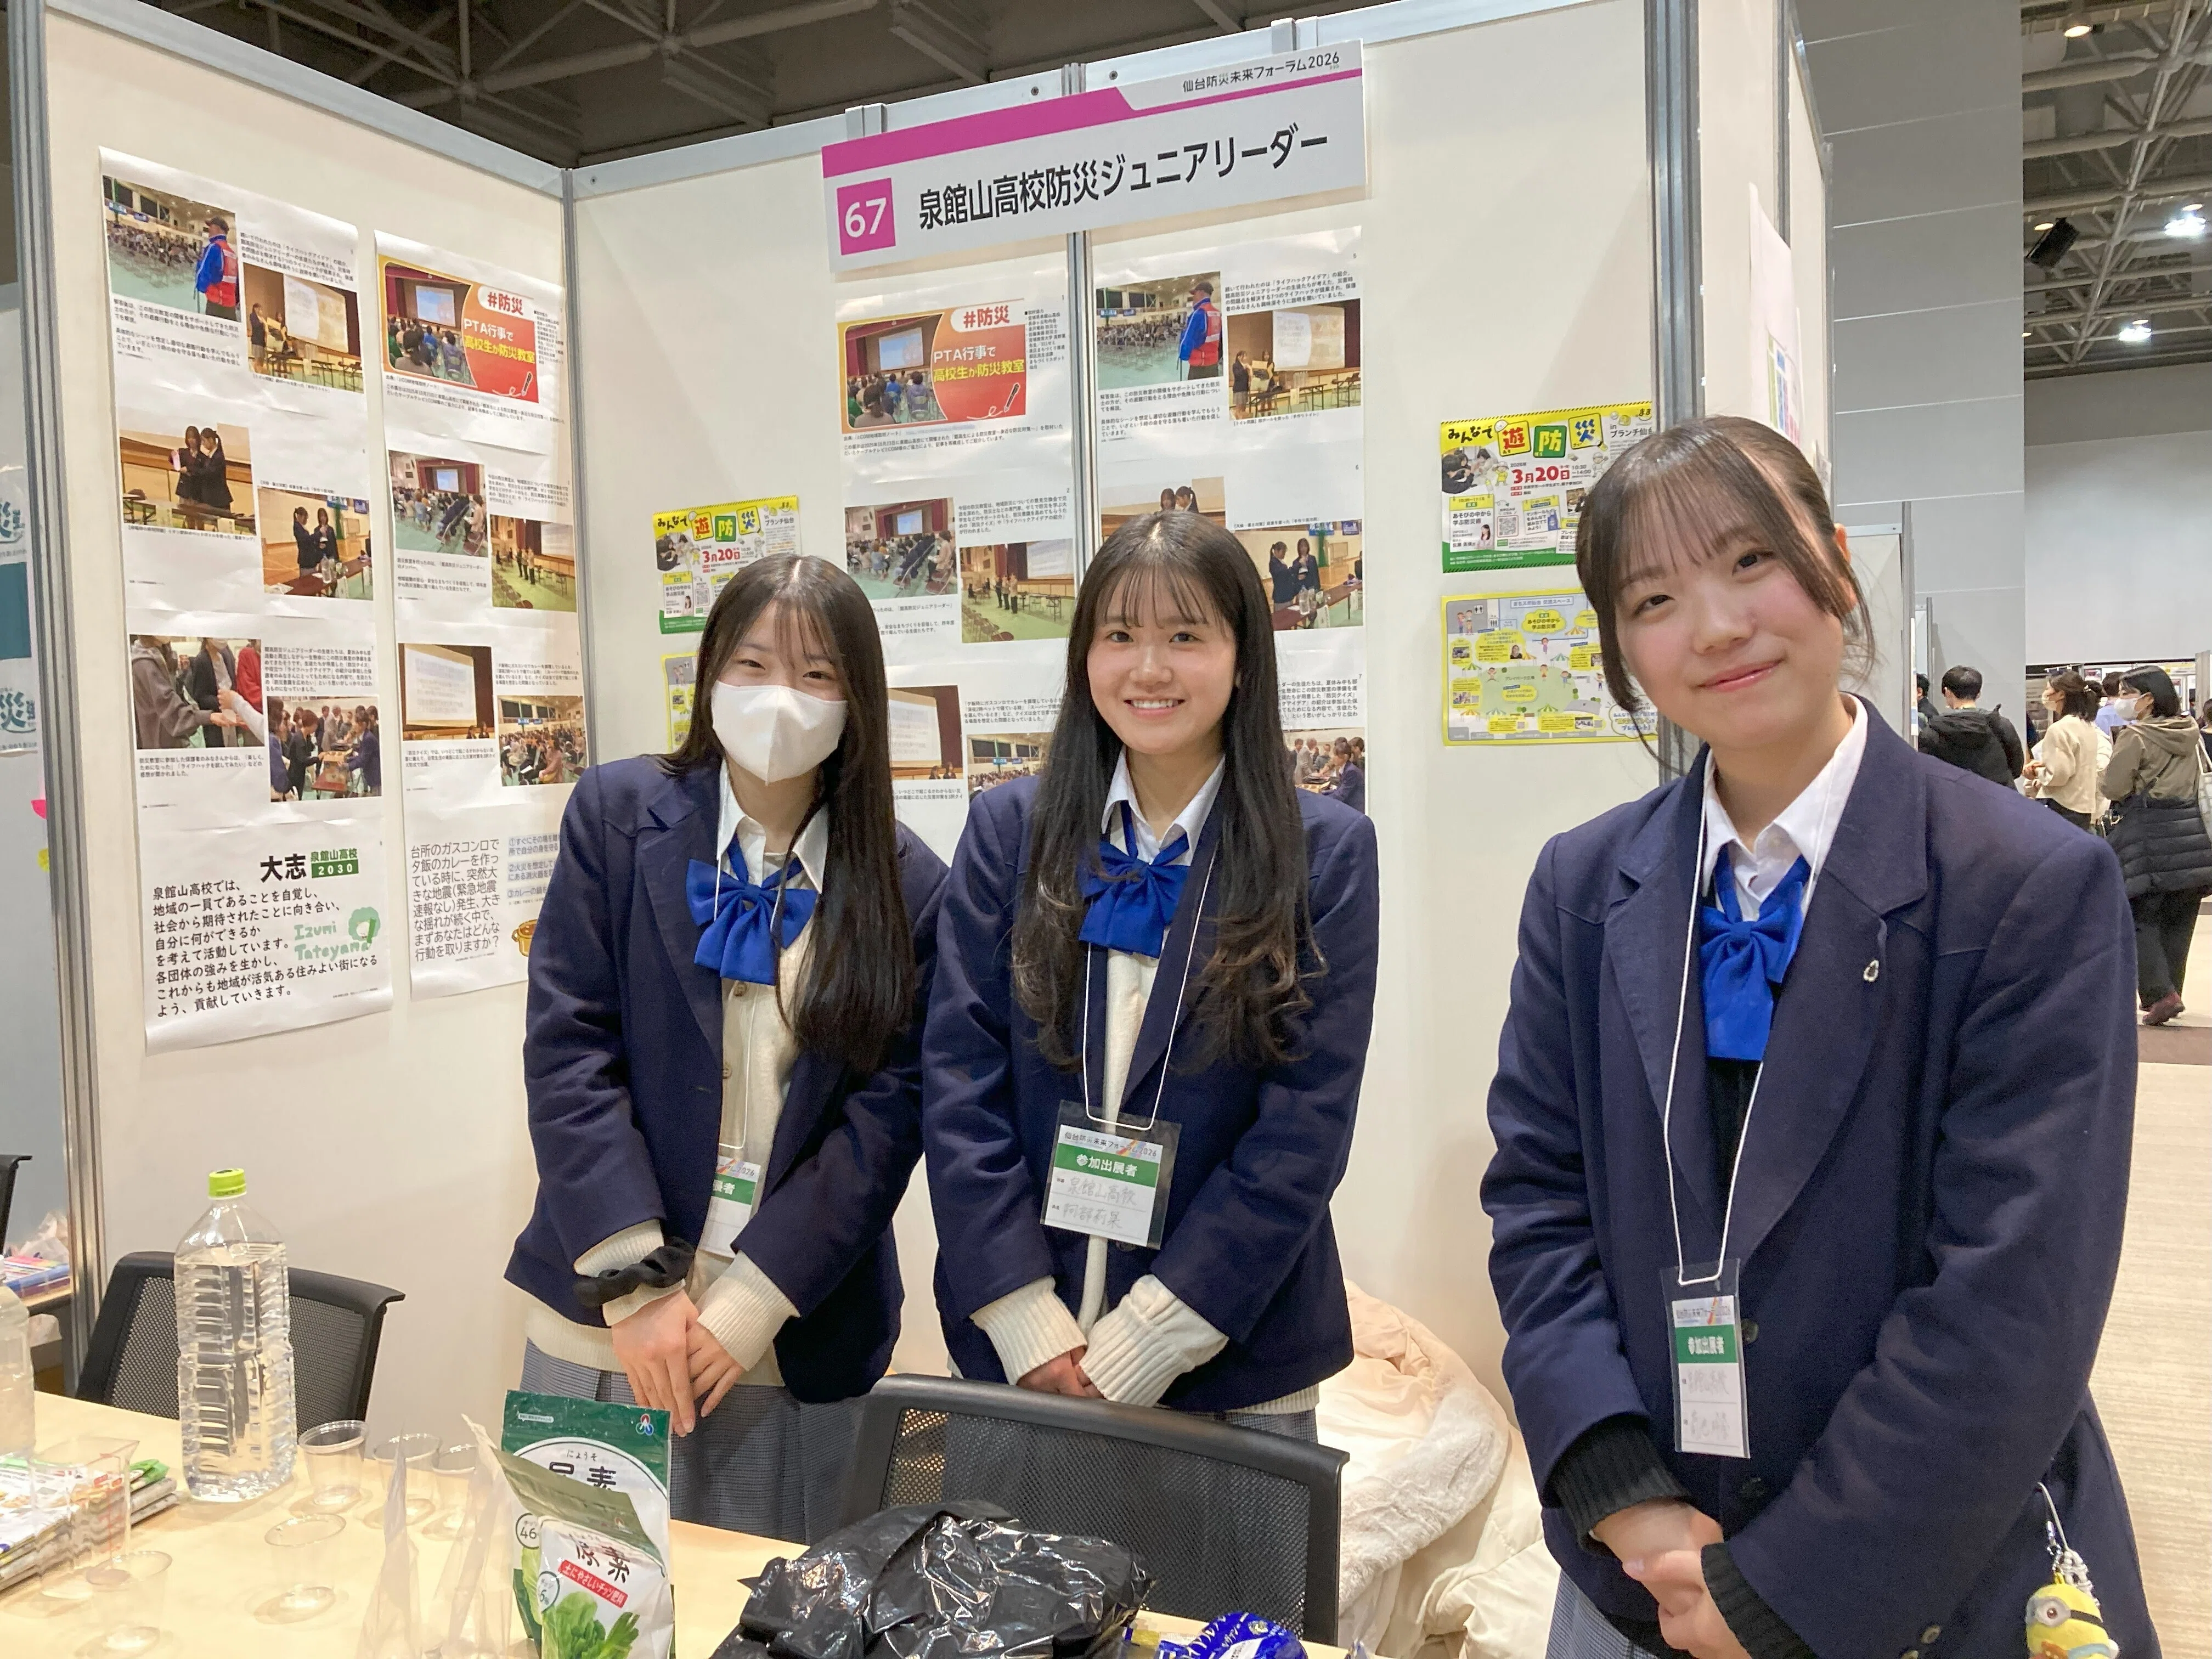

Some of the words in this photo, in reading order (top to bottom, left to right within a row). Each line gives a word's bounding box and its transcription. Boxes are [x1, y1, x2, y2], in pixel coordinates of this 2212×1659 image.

[1182, 51, 1340, 93] 仙台防災未来フォーラム2026
[918, 121, 1328, 230] 泉館山高校防災ジュニアリーダー
[845, 198, 887, 239] 67
[487, 291, 523, 315] #防災
[963, 305, 1010, 328] #防災
[464, 318, 514, 342] PTA行事で
[464, 335, 535, 364] 高校生が防災教室
[934, 345, 996, 363] PTA行事で
[933, 359, 1025, 382] 高校生が防災教室
[1448, 425, 1493, 443] みんなで
[1503, 426, 1526, 449] 遊
[1538, 431, 1562, 451] 防
[1575, 419, 1595, 443] 災
[1511, 466, 1570, 484] 3月20日
[658, 516, 688, 530] みんなで
[694, 517, 710, 535] 遊
[1453, 511, 1491, 519] あそびの中から
[719, 520, 733, 537] 防
[702, 548, 740, 563] 3月20日
[311, 848, 358, 862] 泉館山高校
[411, 839, 500, 859] 台所のガスコンロで
[260, 853, 307, 883] 大志
[318, 863, 353, 876] 2030
[412, 854, 499, 873] 夕飯のカレーを作っ
[153, 879, 241, 900] 泉館山高校では、
[412, 868, 498, 888] ている時に、突然大
[153, 887, 318, 917] 地域の一員であることを自覚し、
[154, 901, 341, 934] 社会から期待されたことに向き合い、
[414, 910, 494, 932] な揺れが続く中で、
[155, 925, 261, 951] 自分に何ができるか
[294, 920, 337, 941] Izumi
[415, 922, 500, 946] まずあなたはどんな
[156, 938, 290, 966] を考えて活動しています。
[294, 940, 369, 961] Tateyama
[156, 955, 279, 985] 各団体の強みを生かし、
[157, 955, 377, 1001] これからも地域が活気ある住みよい街になる
[157, 985, 292, 1018] よう、貢献していきます。
[1076, 1153, 1138, 1177] 参加出展者
[1688, 1335, 1724, 1355] 参加出展者
[519, 1527, 538, 1540] 46
[562, 1563, 628, 1607] 土にやさしいチッソ肥料
